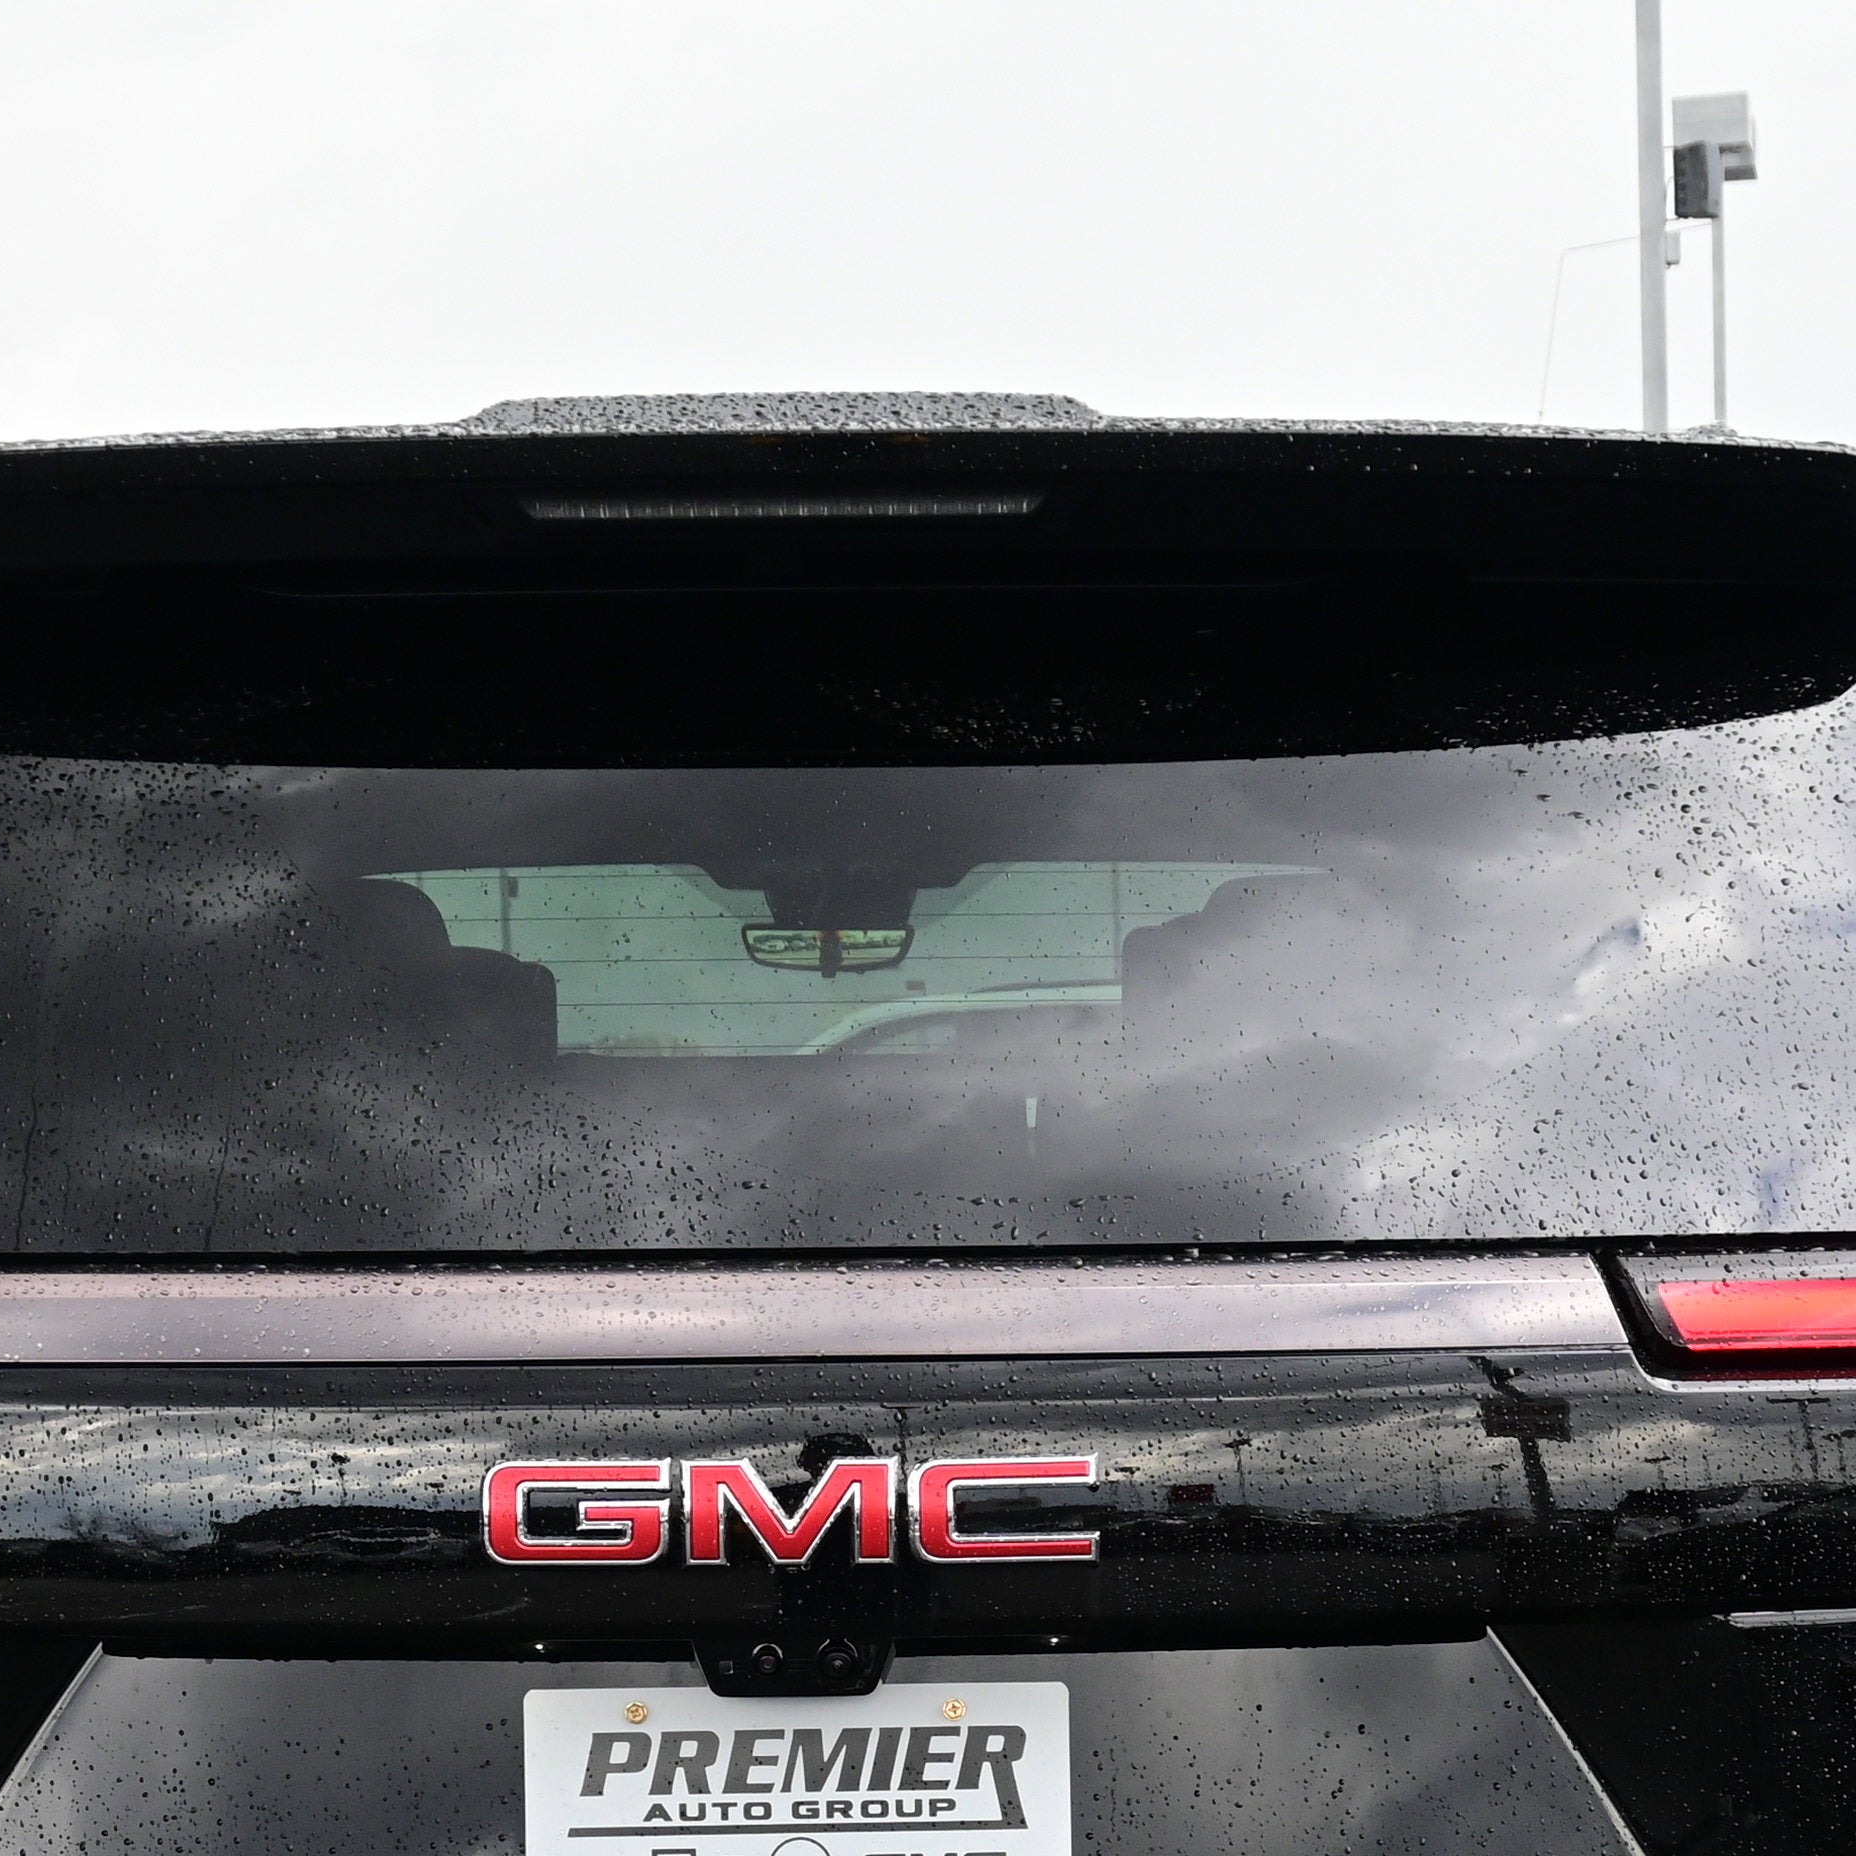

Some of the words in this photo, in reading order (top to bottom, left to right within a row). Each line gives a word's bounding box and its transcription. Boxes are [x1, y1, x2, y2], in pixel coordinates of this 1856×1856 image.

[482, 1452, 1101, 1566] GMC
[579, 1725, 1028, 1829] PREMIER
[644, 1801, 772, 1822] AUTO
[791, 1798, 957, 1820] GROUP
